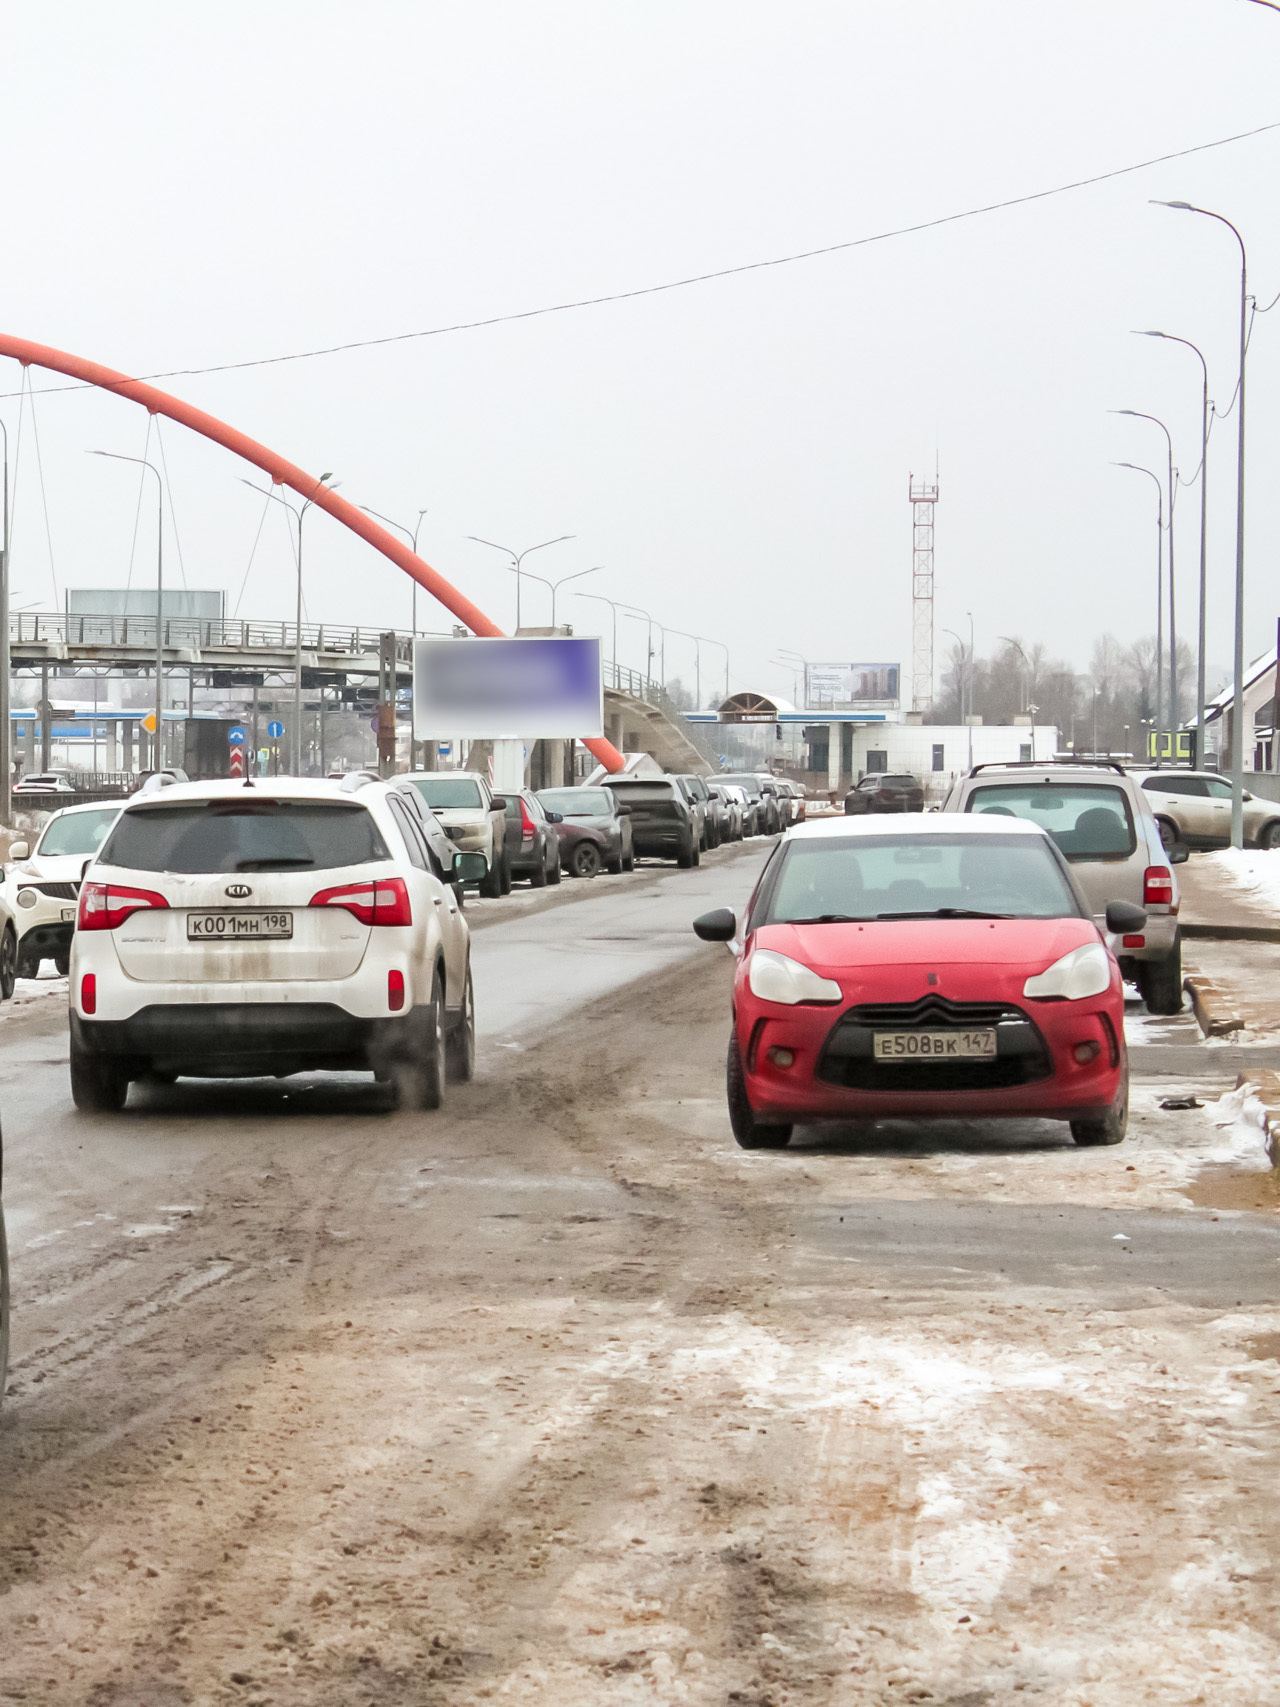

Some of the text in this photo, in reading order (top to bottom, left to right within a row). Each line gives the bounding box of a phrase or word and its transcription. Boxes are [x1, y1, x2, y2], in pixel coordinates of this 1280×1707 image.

[228, 886, 248, 895] KIA
[193, 915, 287, 933] К001МН 198
[881, 1033, 991, 1055] Е508ВК 147
